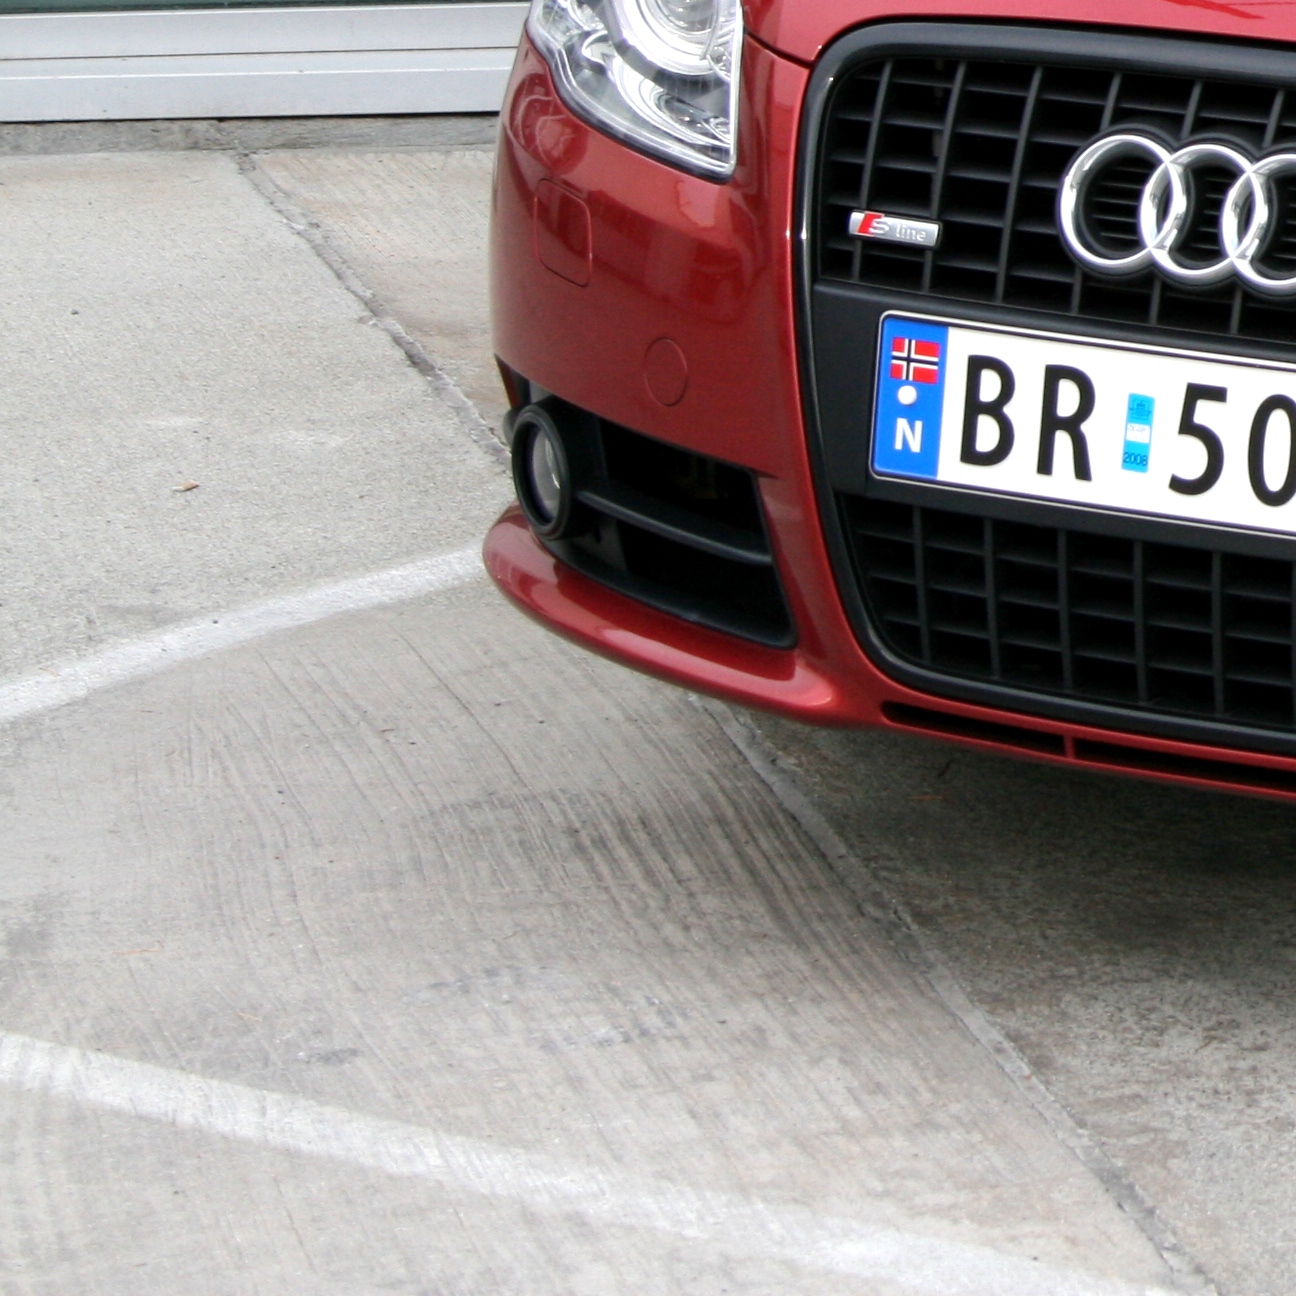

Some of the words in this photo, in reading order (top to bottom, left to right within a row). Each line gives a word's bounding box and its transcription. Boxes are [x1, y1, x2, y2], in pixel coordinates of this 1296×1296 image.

[895, 223, 927, 242] line
[893, 417, 924, 454] N
[960, 354, 1096, 482] BR
